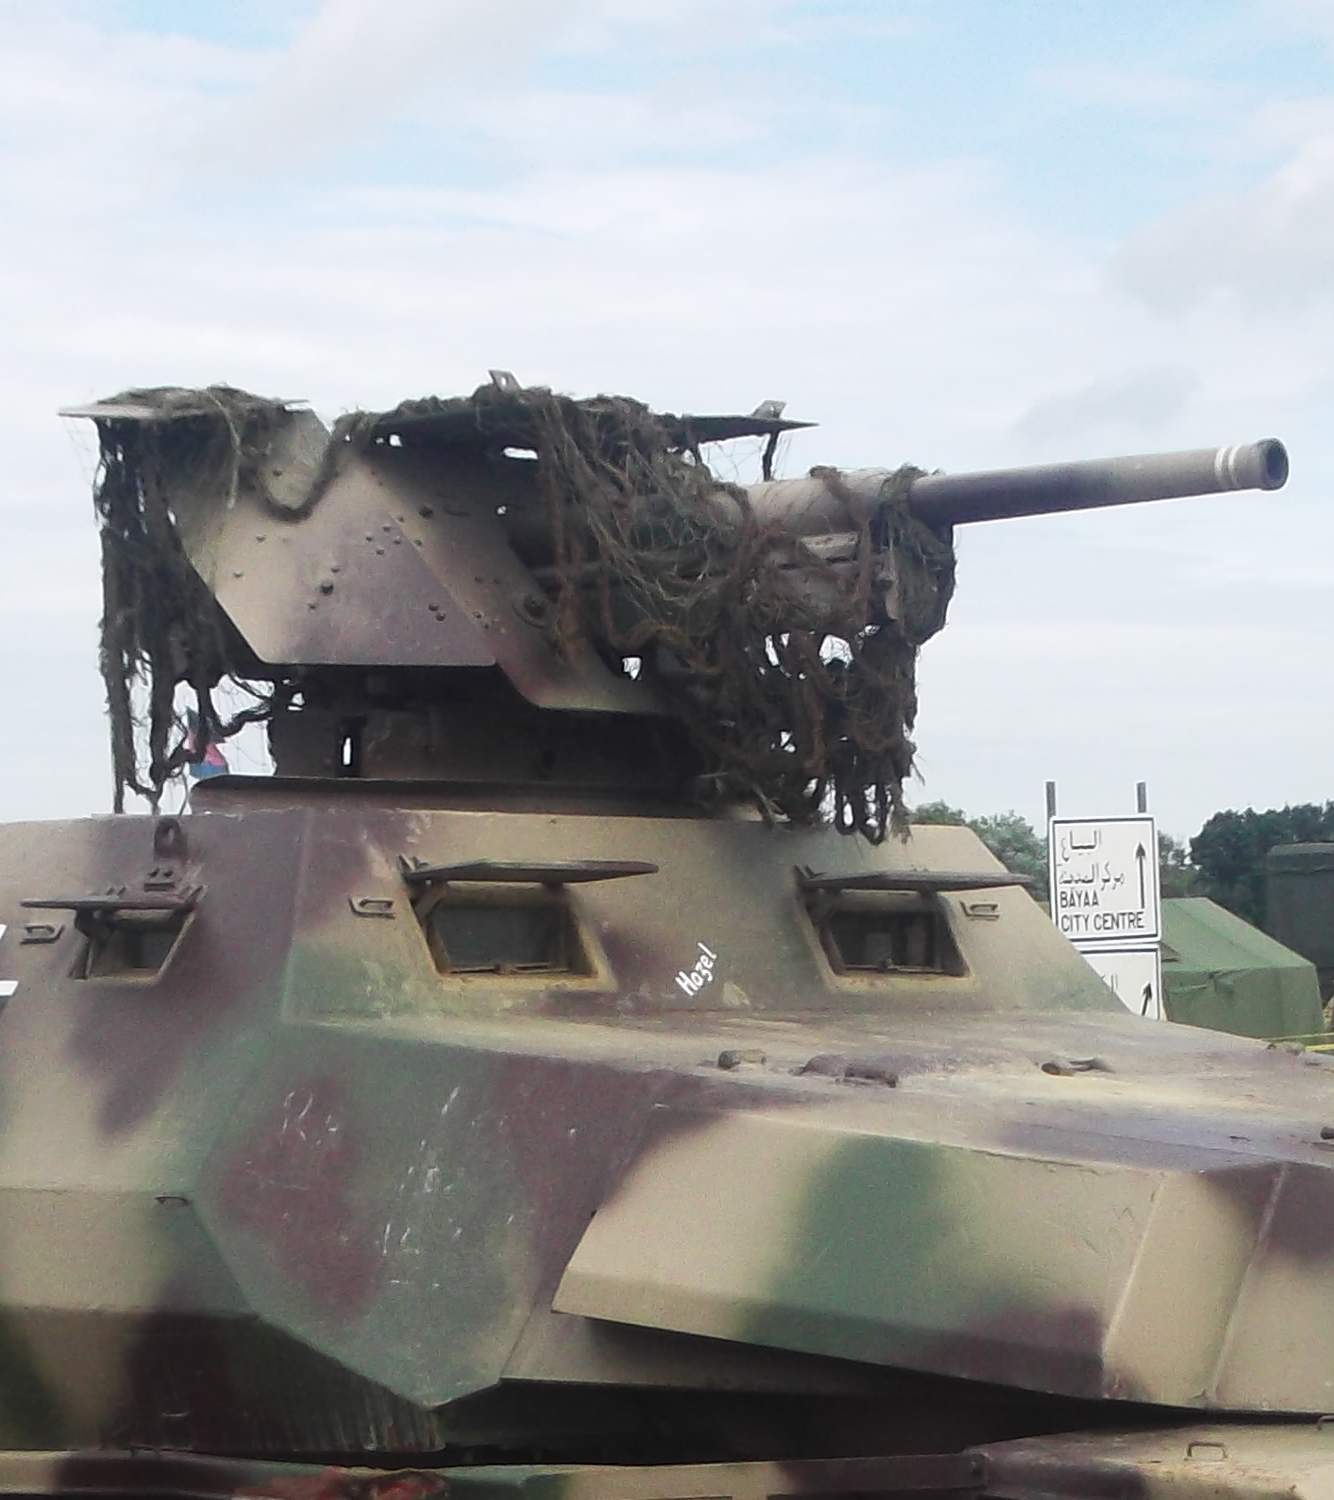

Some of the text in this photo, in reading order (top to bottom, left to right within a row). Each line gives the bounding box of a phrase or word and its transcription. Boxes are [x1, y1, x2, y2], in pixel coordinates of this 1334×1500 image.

[1060, 890, 1100, 909] BAYAA
[1061, 911, 1146, 933] CITY CENTRE
[674, 941, 718, 997] Hazel
